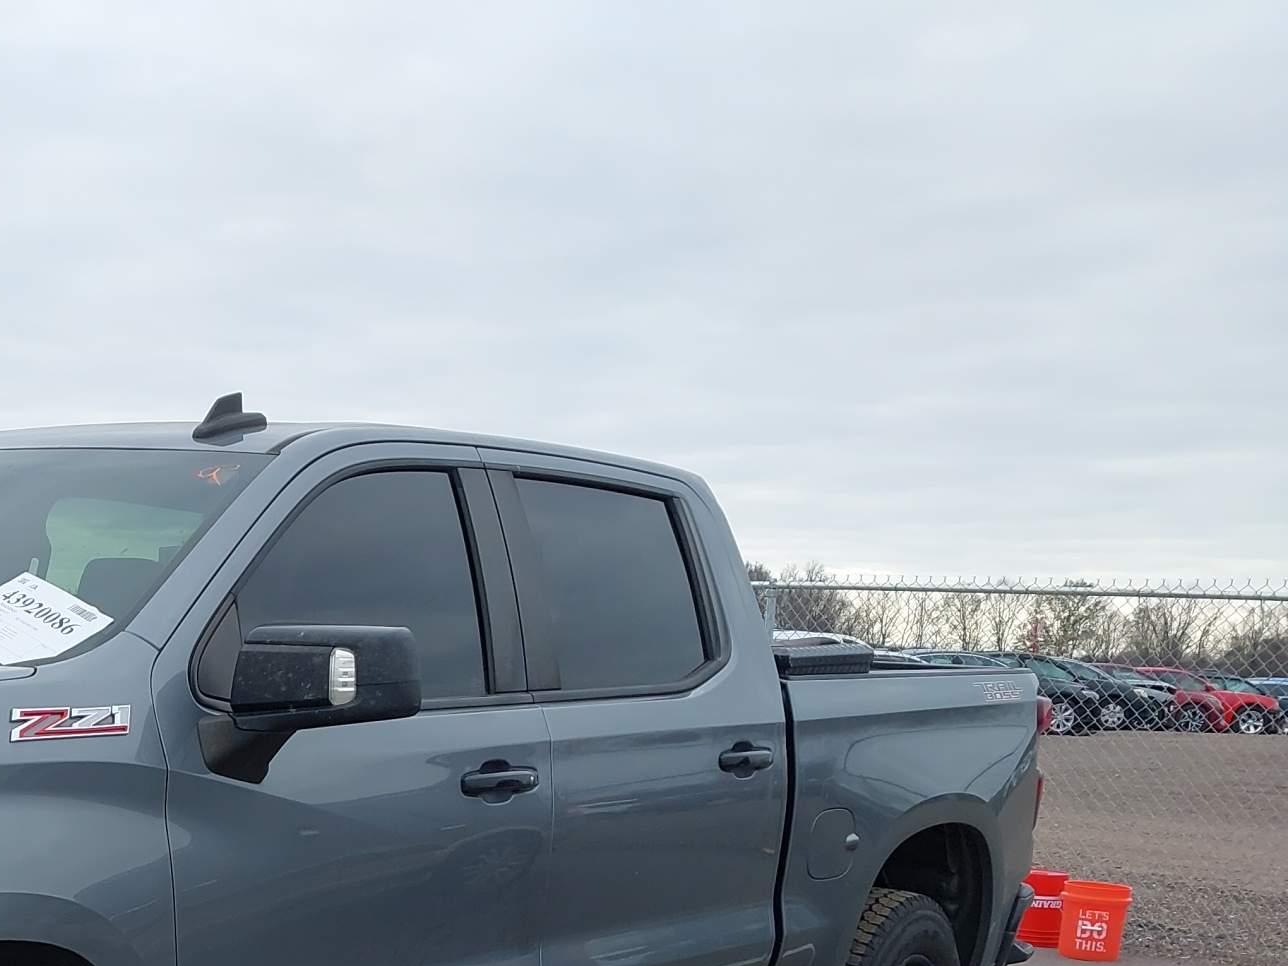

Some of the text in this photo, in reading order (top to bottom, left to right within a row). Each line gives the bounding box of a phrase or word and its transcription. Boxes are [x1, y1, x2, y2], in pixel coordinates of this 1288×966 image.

[1, 590, 81, 635] 43920086
[10, 705, 130, 742] Z71
[1079, 908, 1110, 920] LET'S
[1076, 919, 1108, 940] DO
[1075, 938, 1107, 953] THIS.
